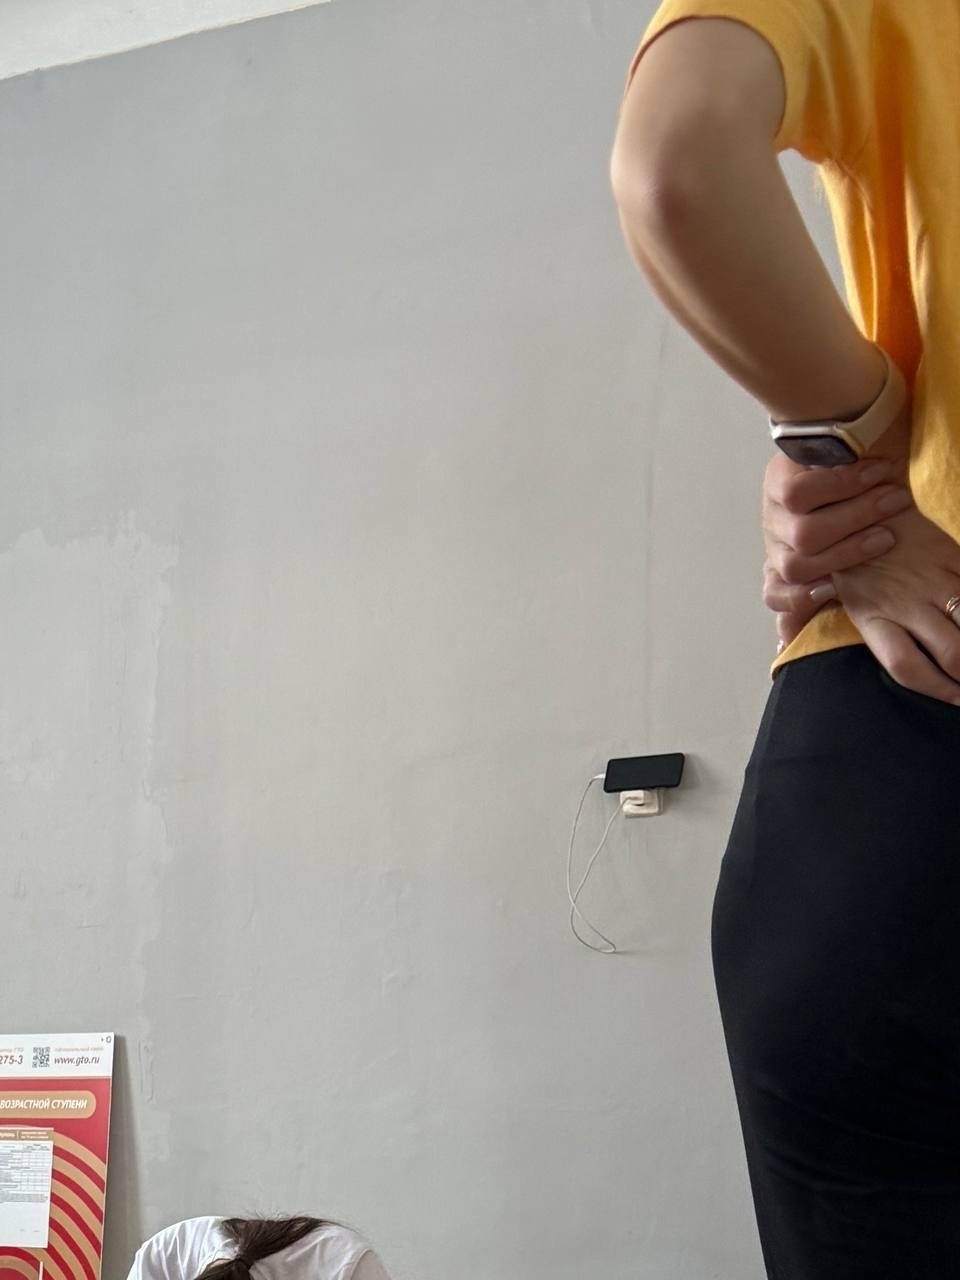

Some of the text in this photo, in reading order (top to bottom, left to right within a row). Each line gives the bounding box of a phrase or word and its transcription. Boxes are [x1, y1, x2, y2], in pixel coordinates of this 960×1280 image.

[54, 1056, 100, 1068] www.gto.ru
[0, 1098, 51, 1109] ВОЗРАСТНОЙ
[51, 1099, 88, 1109] СТУПЕНИ
